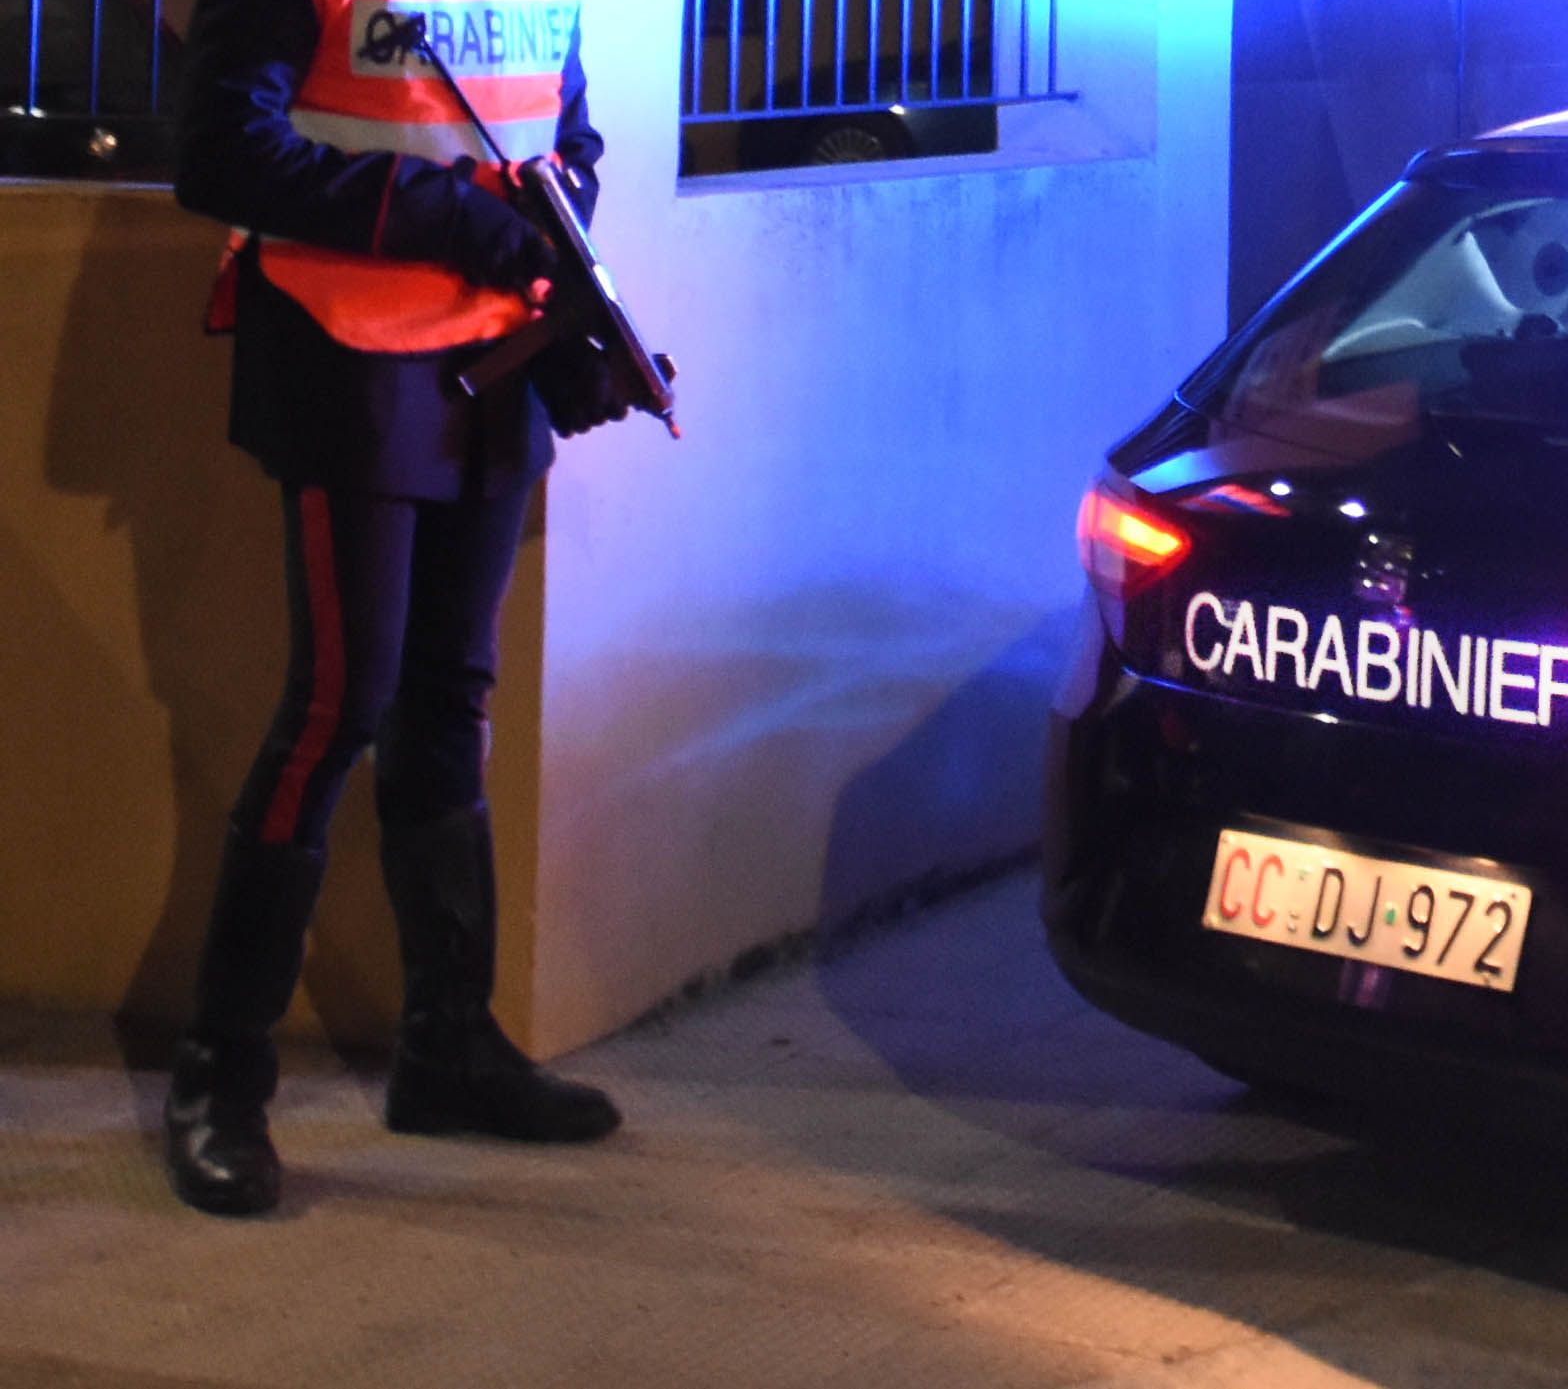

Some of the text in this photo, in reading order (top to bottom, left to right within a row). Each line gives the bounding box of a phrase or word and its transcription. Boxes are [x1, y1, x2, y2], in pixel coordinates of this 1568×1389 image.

[1218, 847, 1513, 975] CC DJ 972
